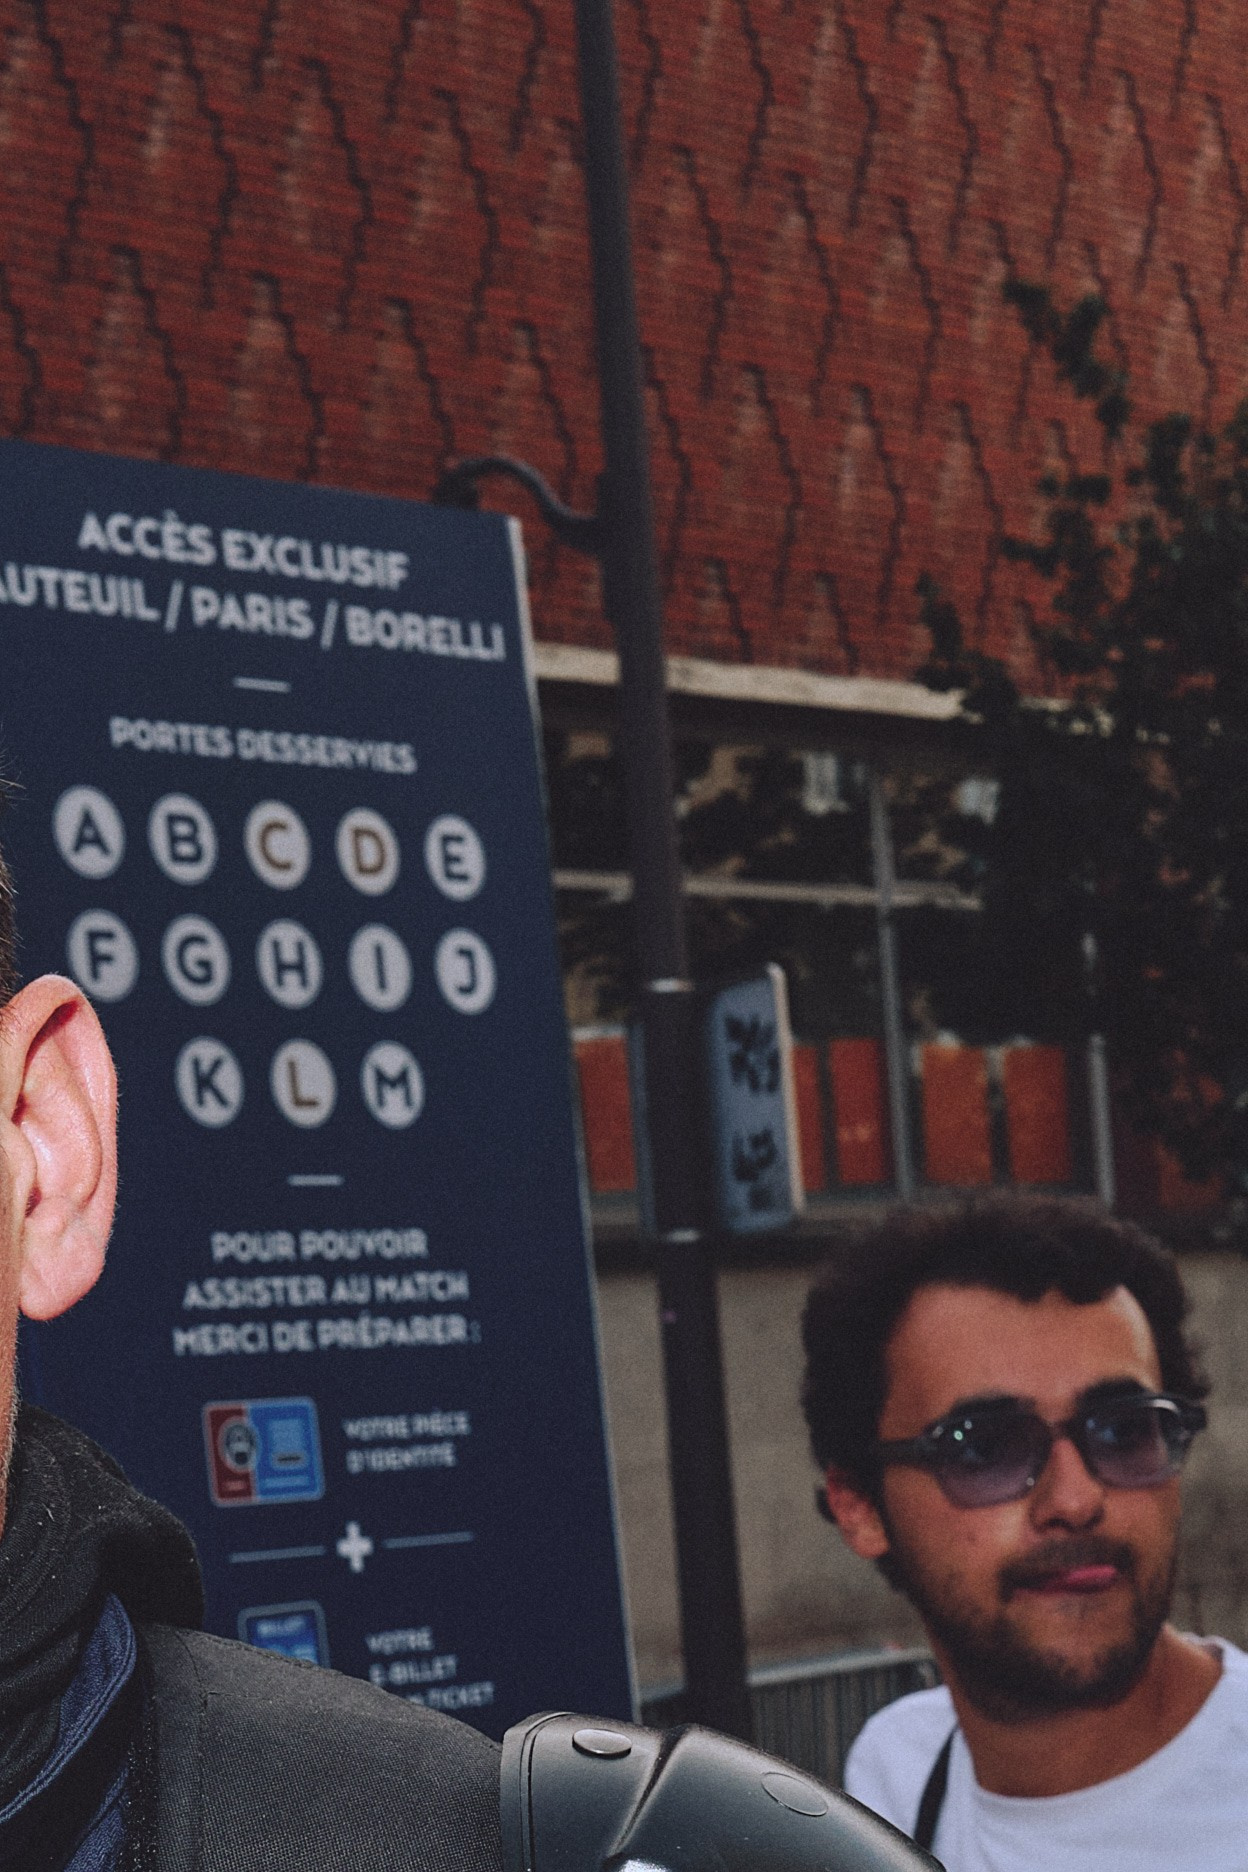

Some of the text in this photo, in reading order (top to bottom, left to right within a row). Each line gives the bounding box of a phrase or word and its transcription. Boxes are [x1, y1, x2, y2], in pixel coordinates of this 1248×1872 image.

[77, 510, 410, 589] ACCÈS EXCLUSIF
[191, 586, 312, 641] PARIS
[345, 604, 507, 661] BORELLI
[109, 716, 417, 774] PORTES DESSERVIES
[72, 809, 470, 882] A B C D E
[88, 930, 116, 979] F
[176, 935, 213, 984] G
[272, 939, 308, 987] H
[455, 947, 478, 995] J
[193, 1057, 412, 1108] K L M
[211, 1228, 428, 1263] POUR POUVOIR
[183, 1270, 470, 1309] ASSISTER AU MATCH
[172, 1325, 269, 1357] MERCI
[273, 1322, 313, 1353] DE
